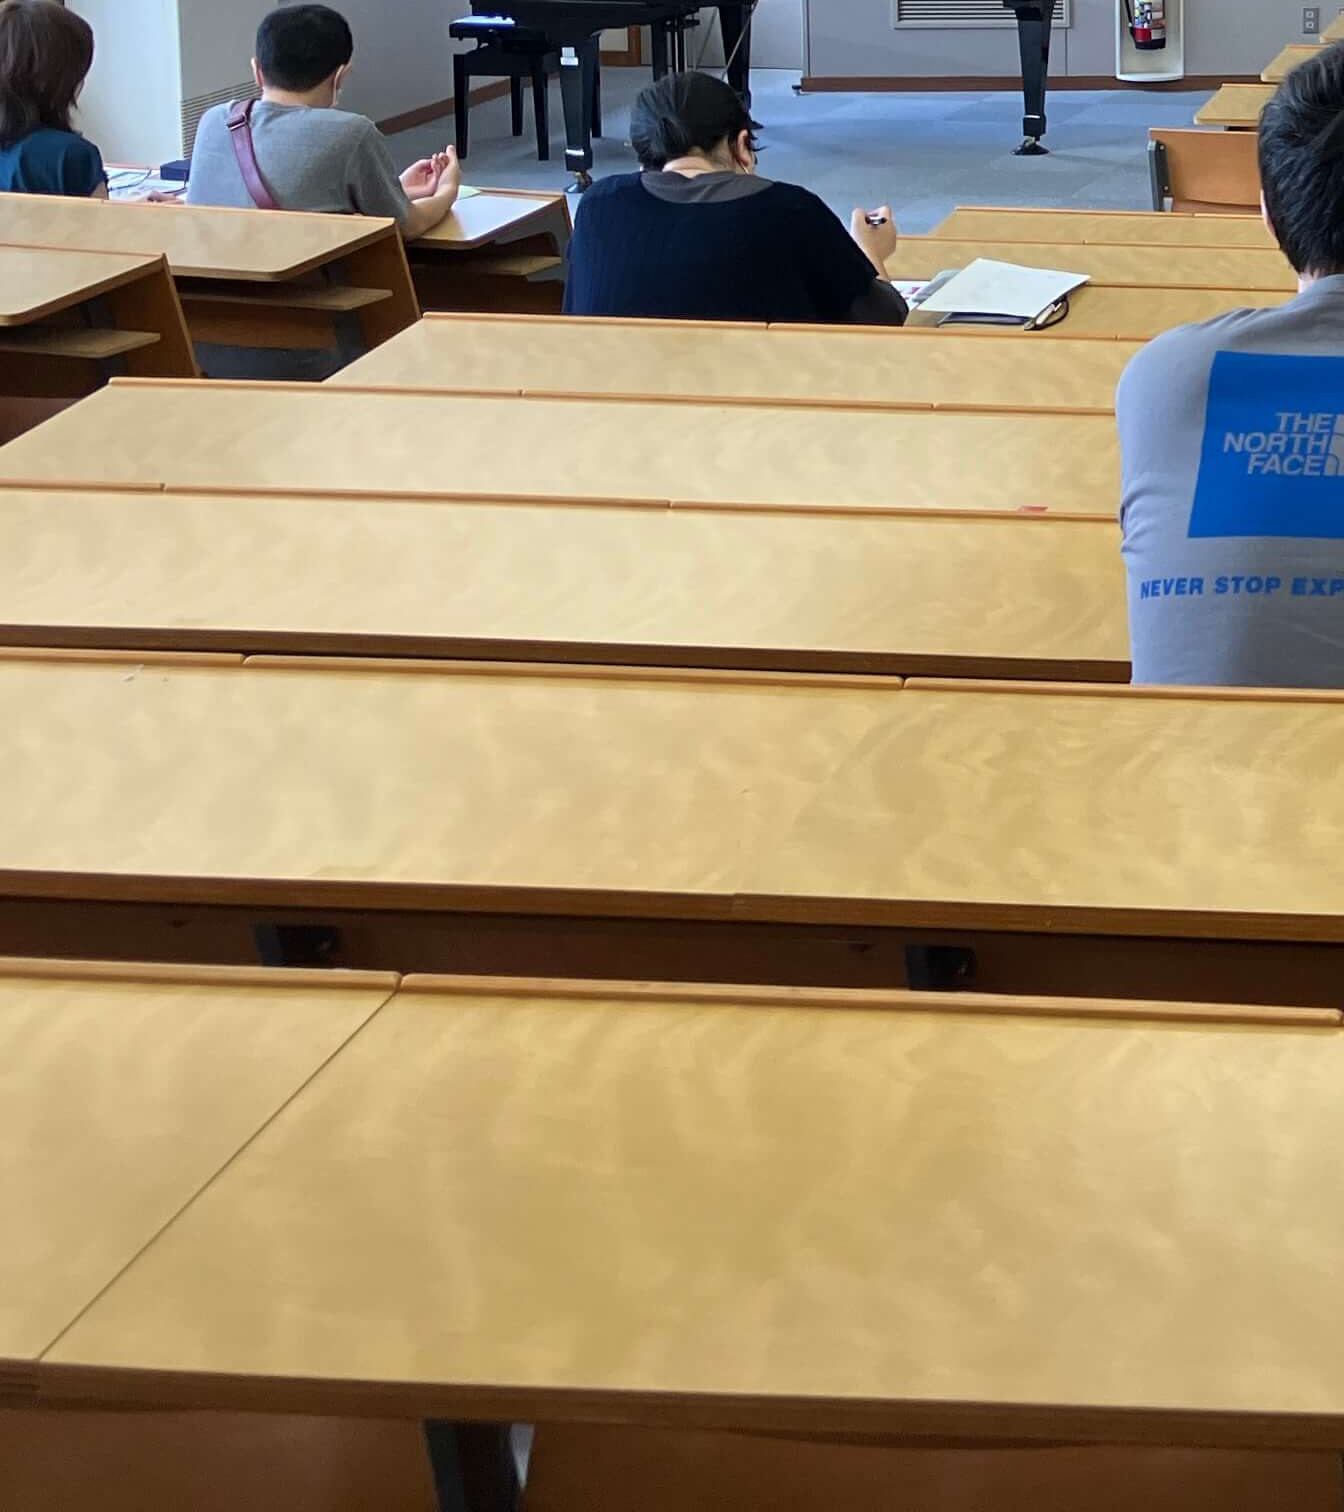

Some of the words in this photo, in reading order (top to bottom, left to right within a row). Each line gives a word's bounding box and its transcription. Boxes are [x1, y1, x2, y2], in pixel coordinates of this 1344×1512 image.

[1275, 412, 1335, 433] THE
[1223, 432, 1330, 454] NORTH
[1247, 453, 1325, 476] FACE
[1140, 577, 1204, 600] NEVER
[1214, 576, 1281, 594] STOP
